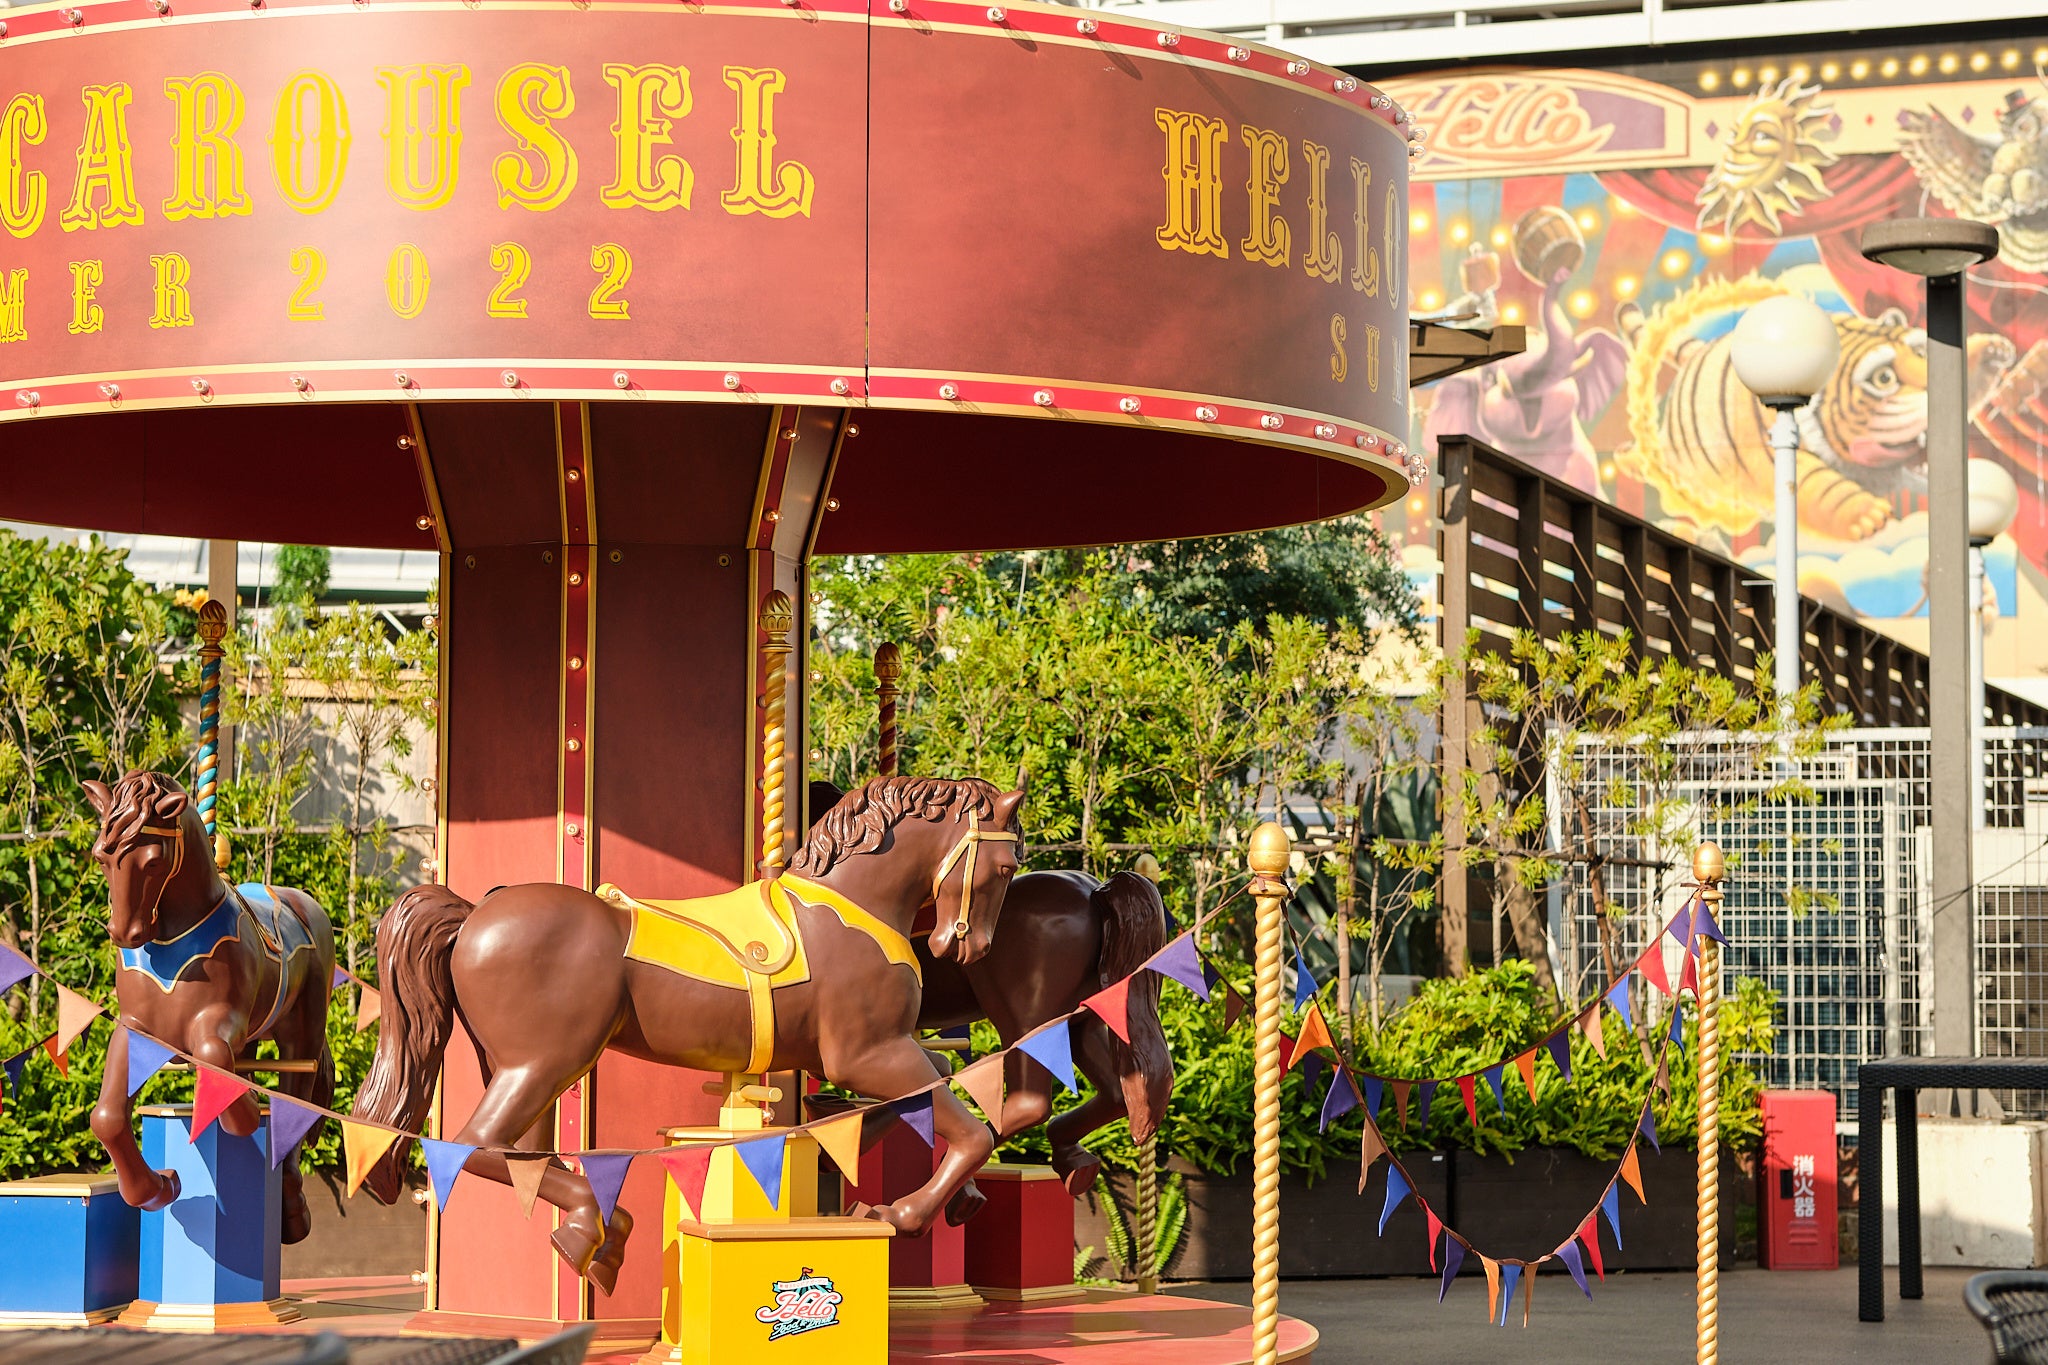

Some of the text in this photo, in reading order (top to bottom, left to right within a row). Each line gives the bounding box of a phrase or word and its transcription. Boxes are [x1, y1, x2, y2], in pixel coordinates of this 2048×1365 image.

[0, 62, 815, 239] CAROUSEL
[1155, 107, 1401, 310] HELLO
[288, 242, 634, 321] 2022
[1793, 1155, 1815, 1218] 消火器
[758, 1291, 839, 1320] Hello
